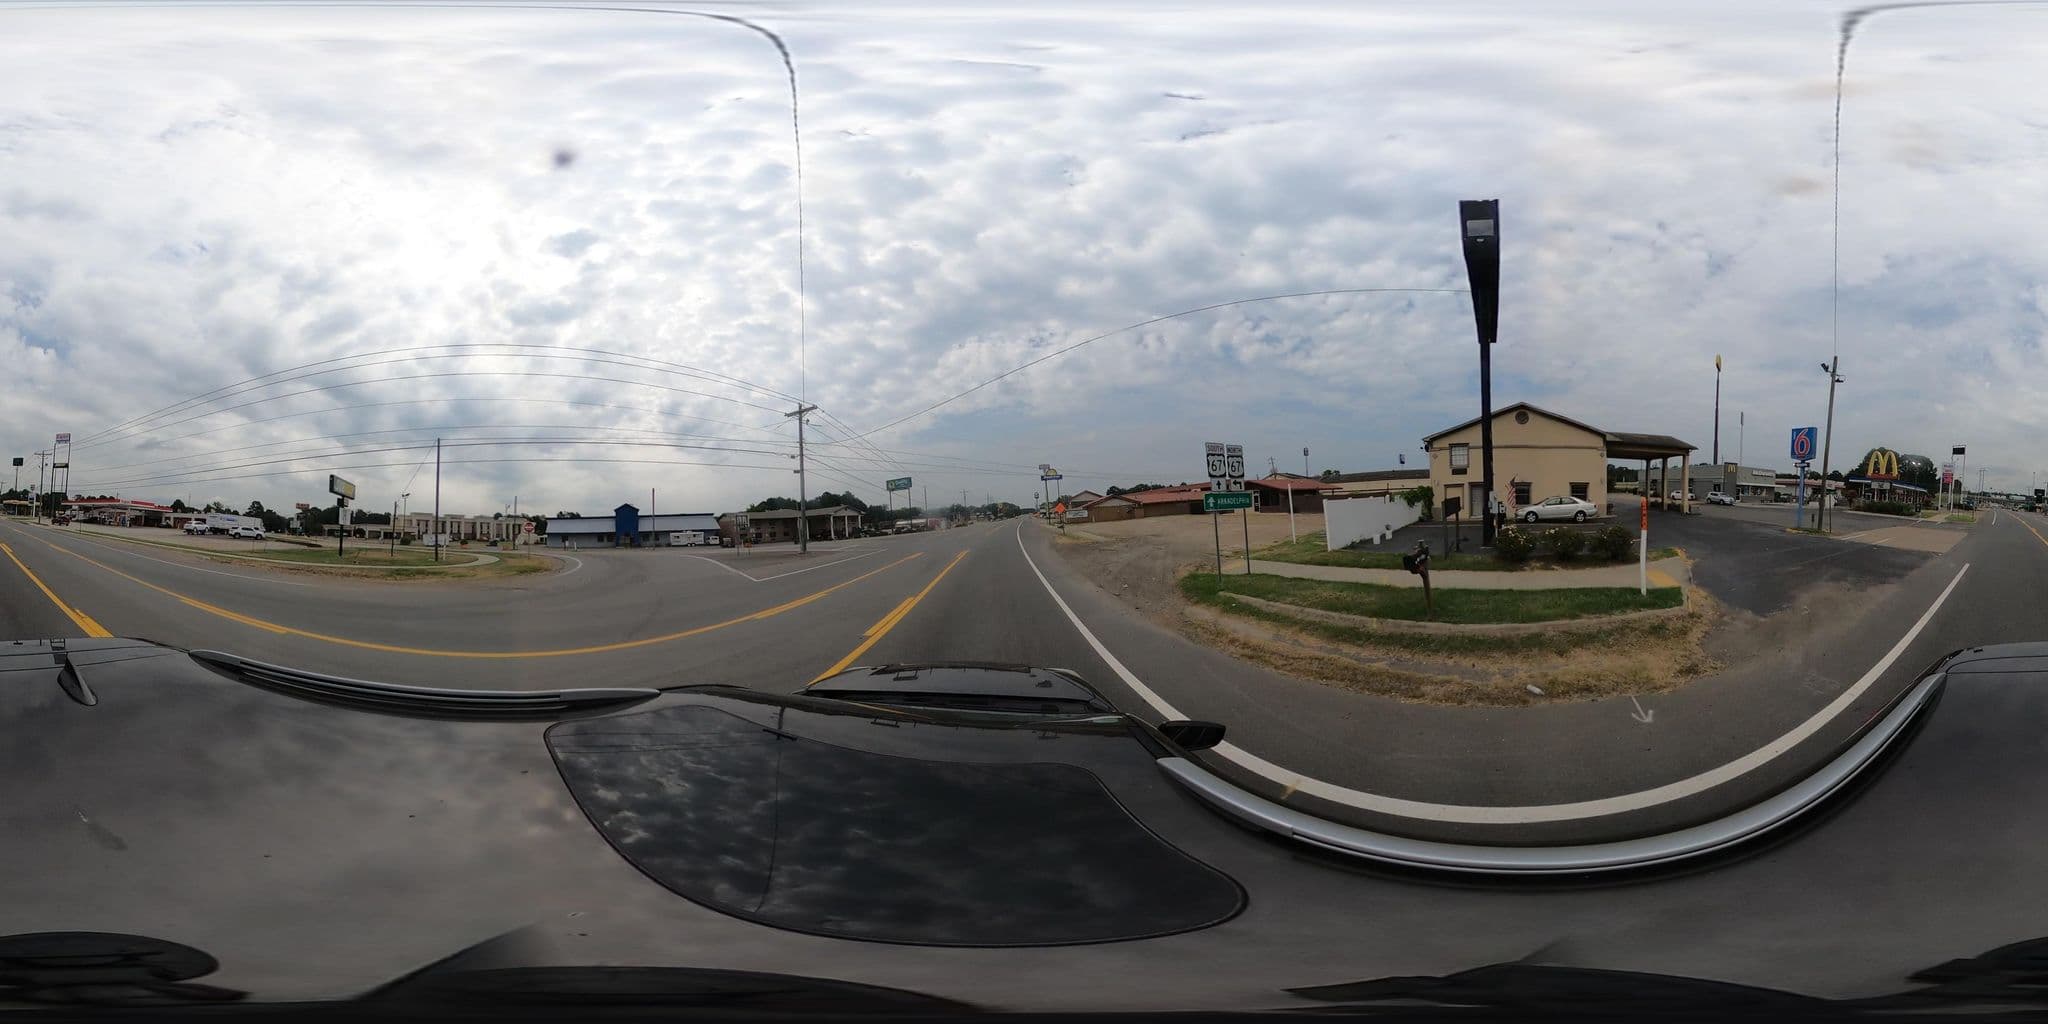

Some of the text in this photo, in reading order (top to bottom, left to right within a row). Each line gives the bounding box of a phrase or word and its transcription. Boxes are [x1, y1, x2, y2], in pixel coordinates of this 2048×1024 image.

[1207, 444, 1224, 453] SOUTH
[1794, 428, 1811, 457] 6
[1211, 459, 1222, 472] 67
[1231, 460, 1241, 473] 67
[1217, 496, 1250, 505] ARKADELPHIA
